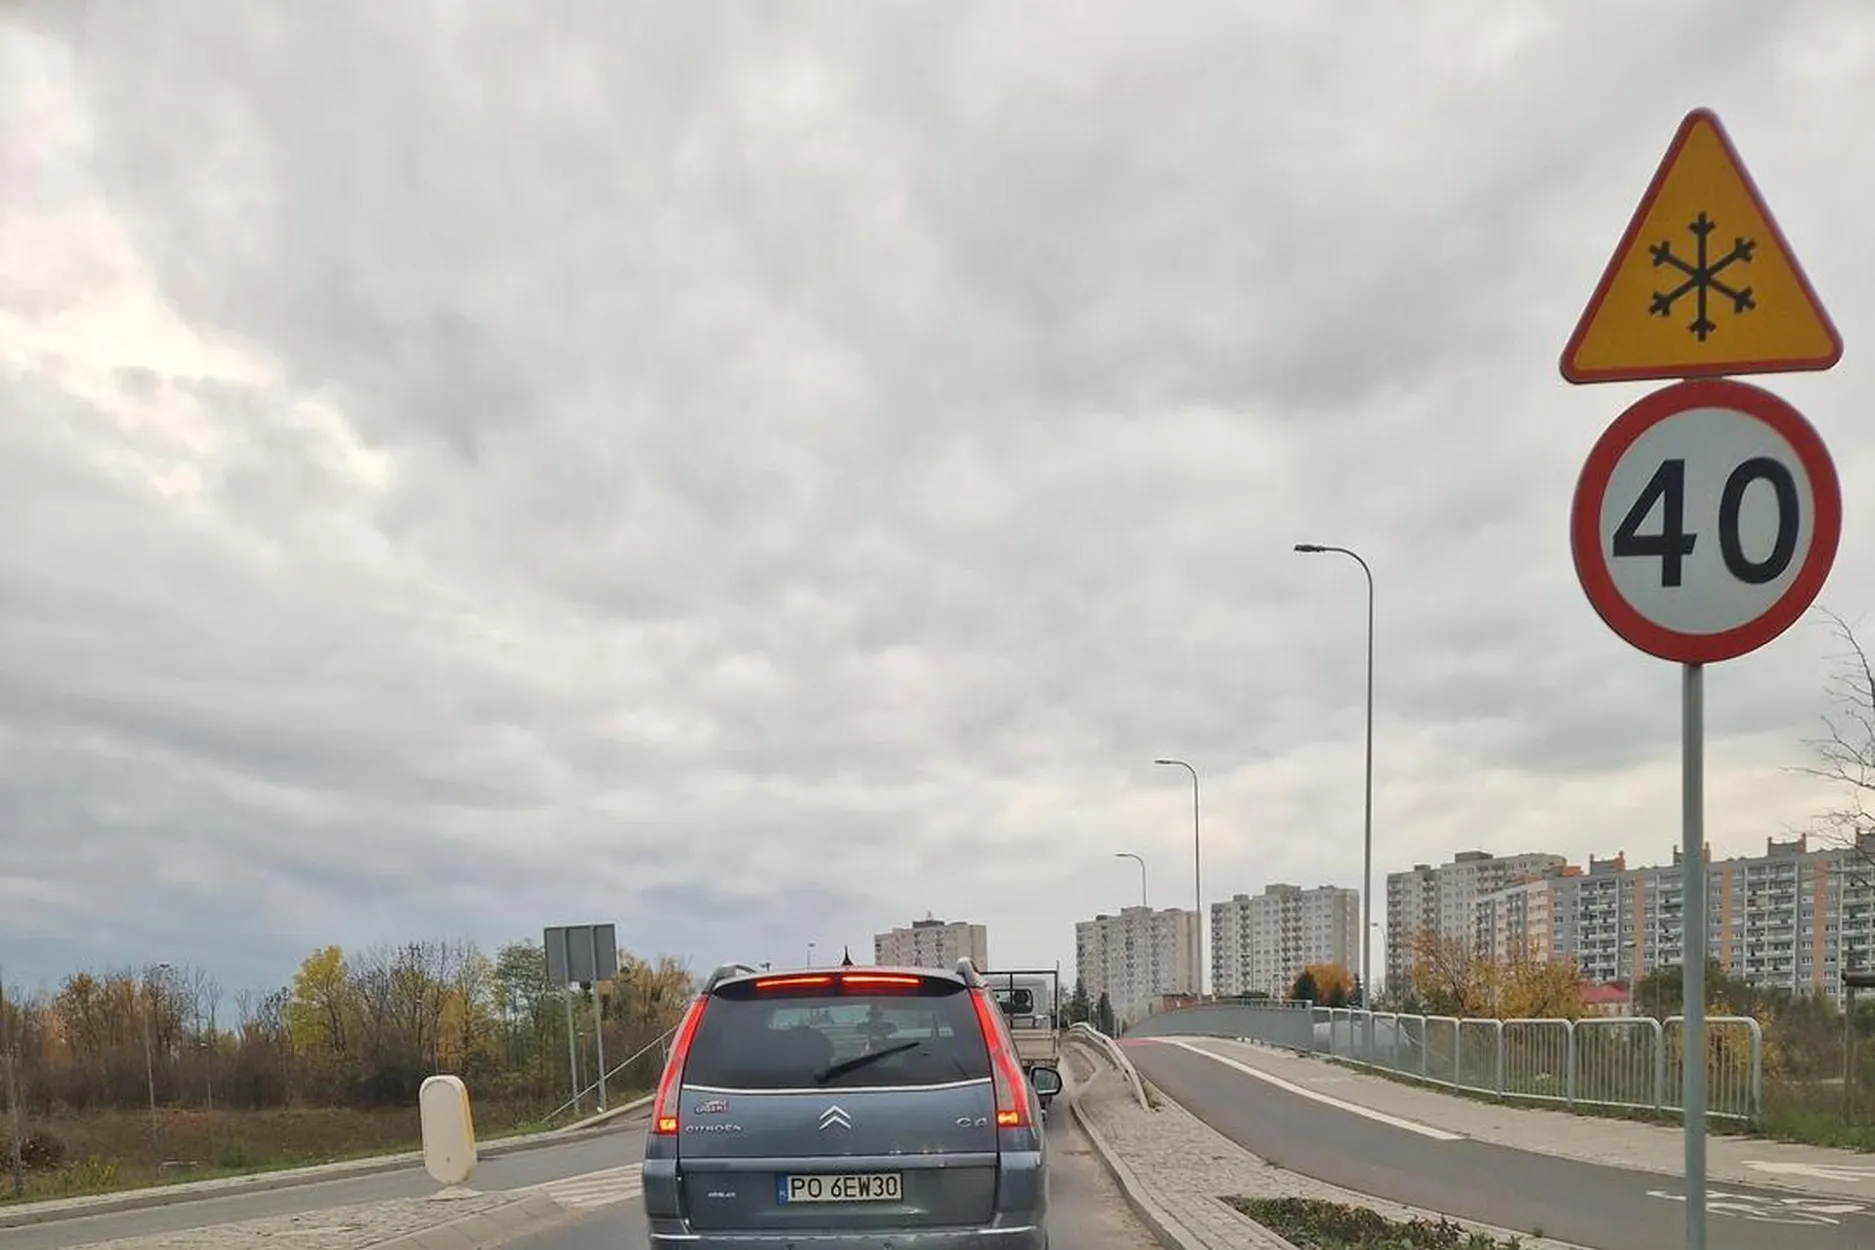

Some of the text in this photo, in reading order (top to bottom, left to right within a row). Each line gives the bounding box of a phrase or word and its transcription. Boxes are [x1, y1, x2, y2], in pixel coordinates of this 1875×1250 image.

[1612, 456, 1799, 587] 40
[790, 1178, 822, 1198] PO
[831, 1176, 898, 1197] 6EW30
